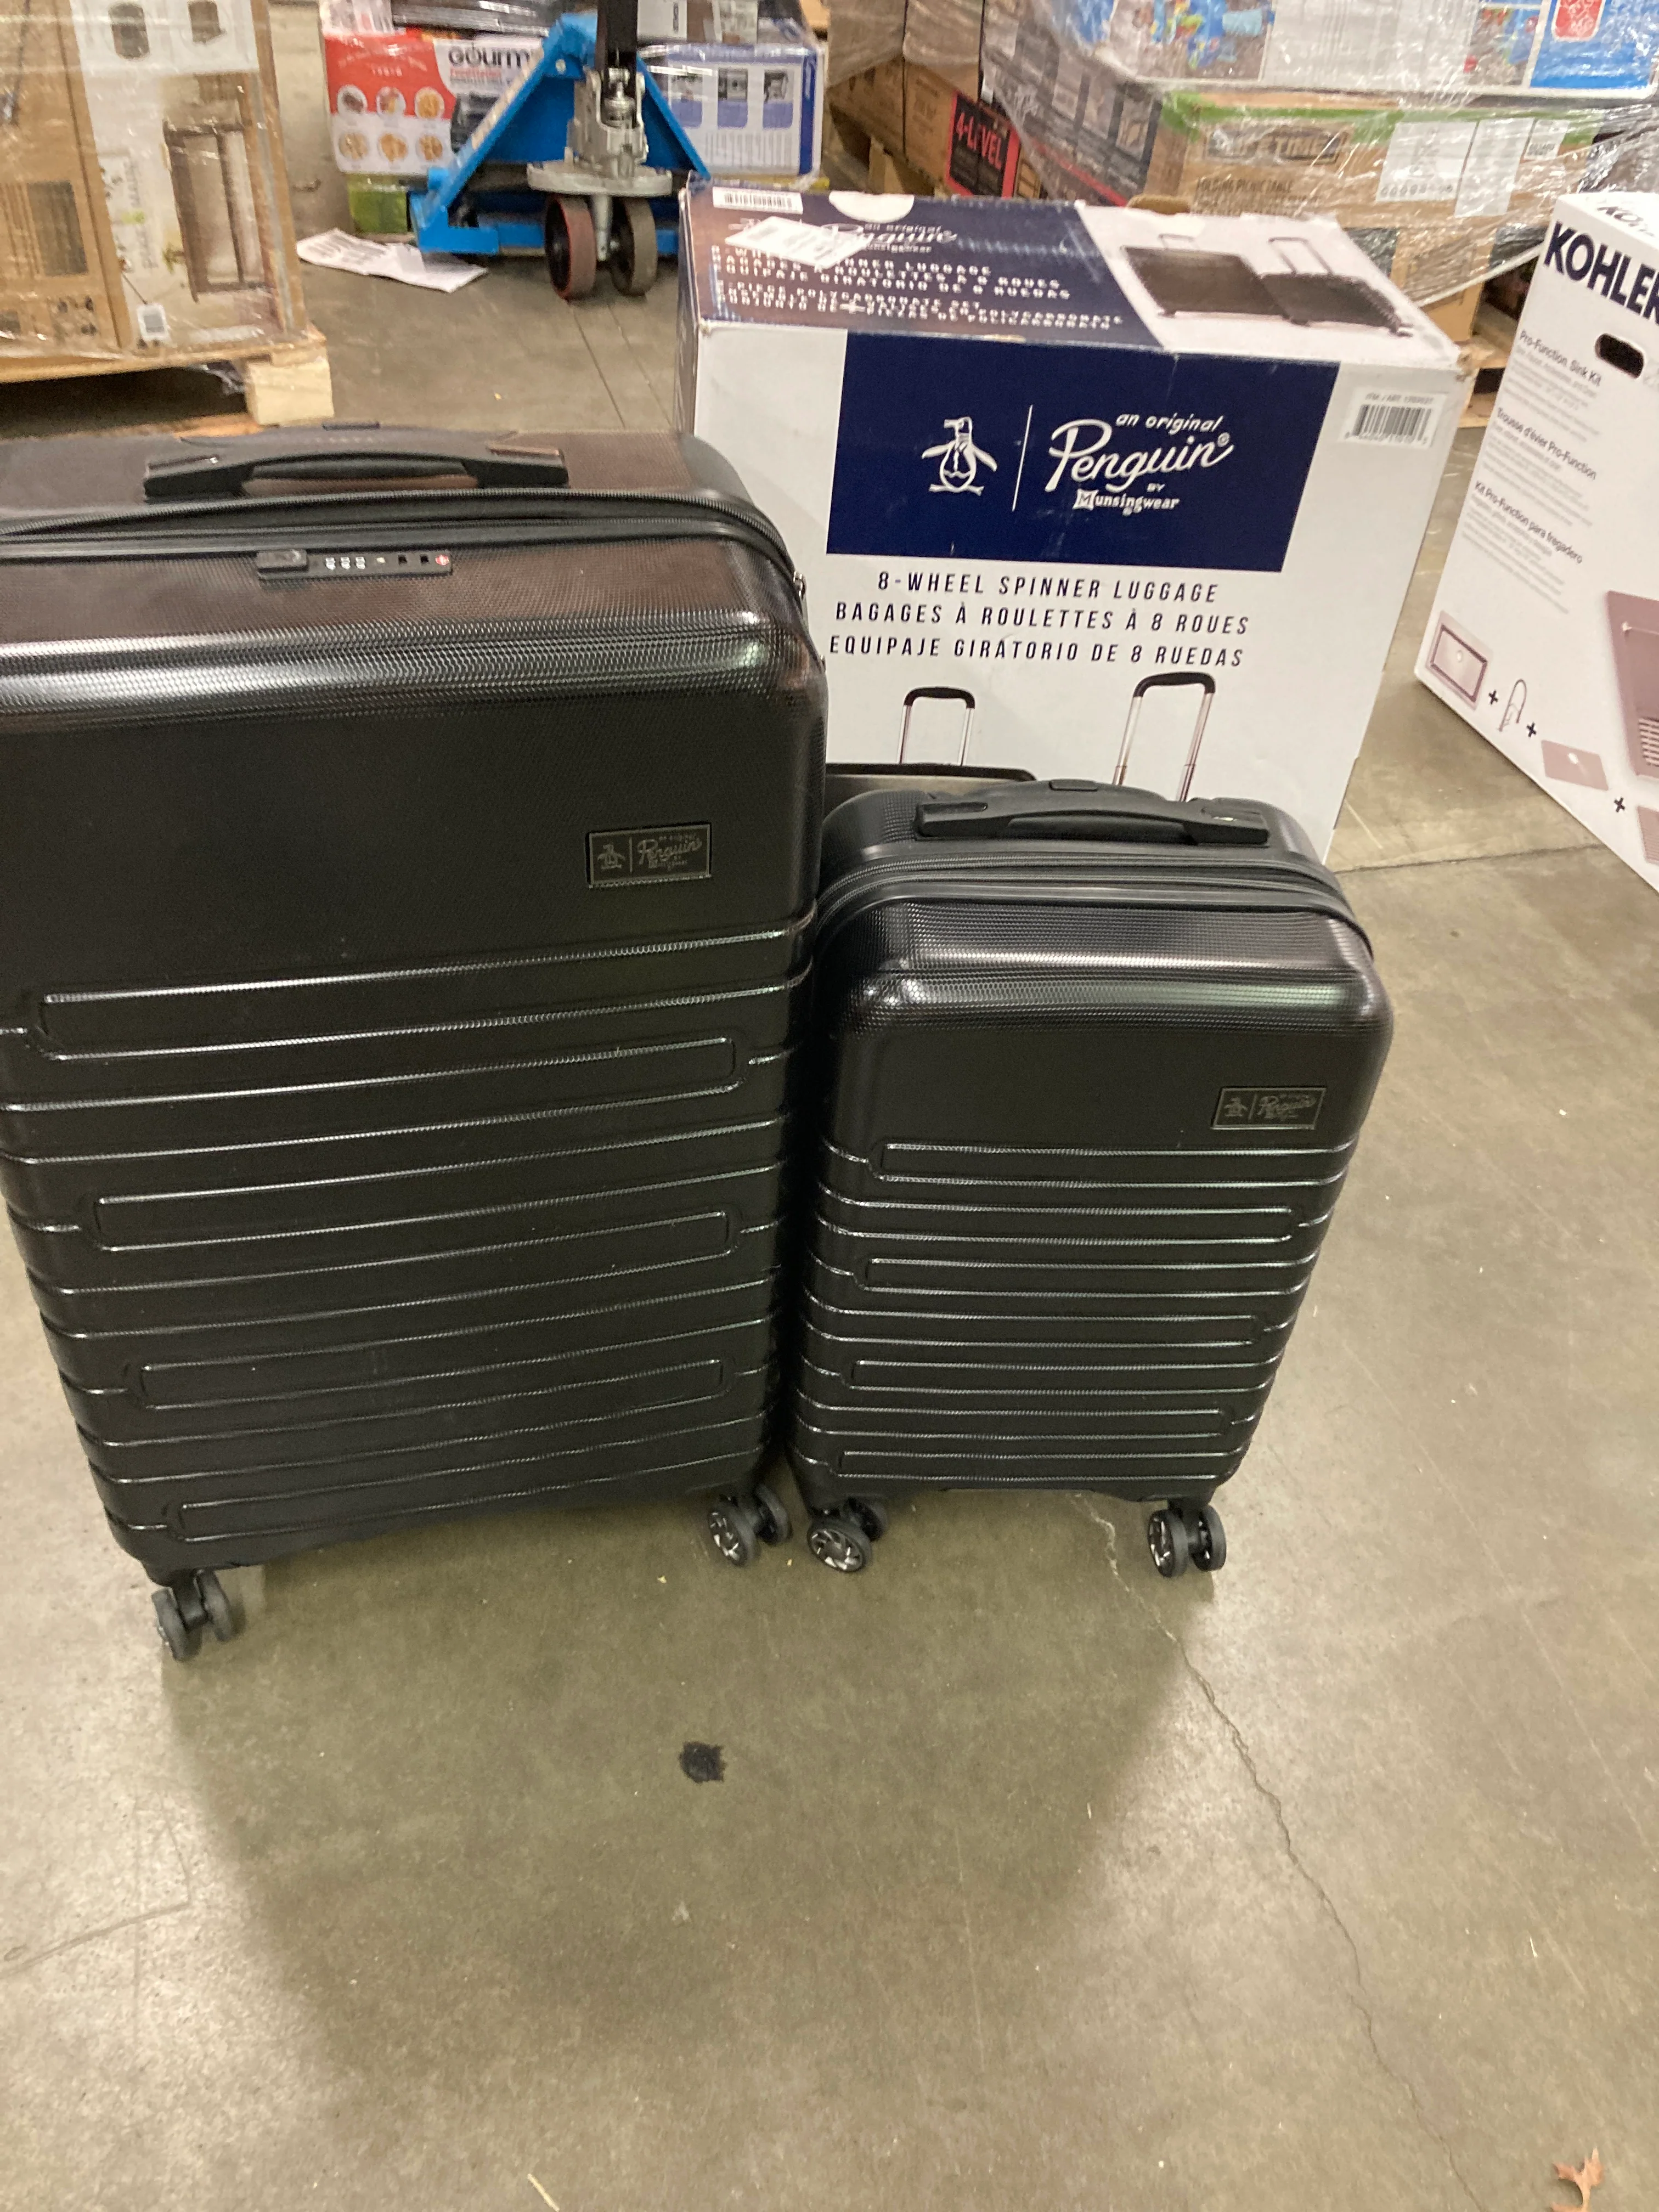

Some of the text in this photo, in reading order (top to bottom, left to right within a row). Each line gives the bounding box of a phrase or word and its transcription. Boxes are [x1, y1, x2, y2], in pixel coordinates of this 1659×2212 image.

[1115, 411, 1224, 436] an original
[1072, 488, 1180, 516] Munsingwear
[1146, 483, 1166, 492] BY
[878, 571, 1219, 603] 8-WHEEL SPINNER LUGGAGE
[836, 601, 1249, 635] BAGAGES À ROULETTES À 8 ROUES
[829, 634, 1244, 668] EQUIPAJE GIRATORIO DE 8 RUEDAS
